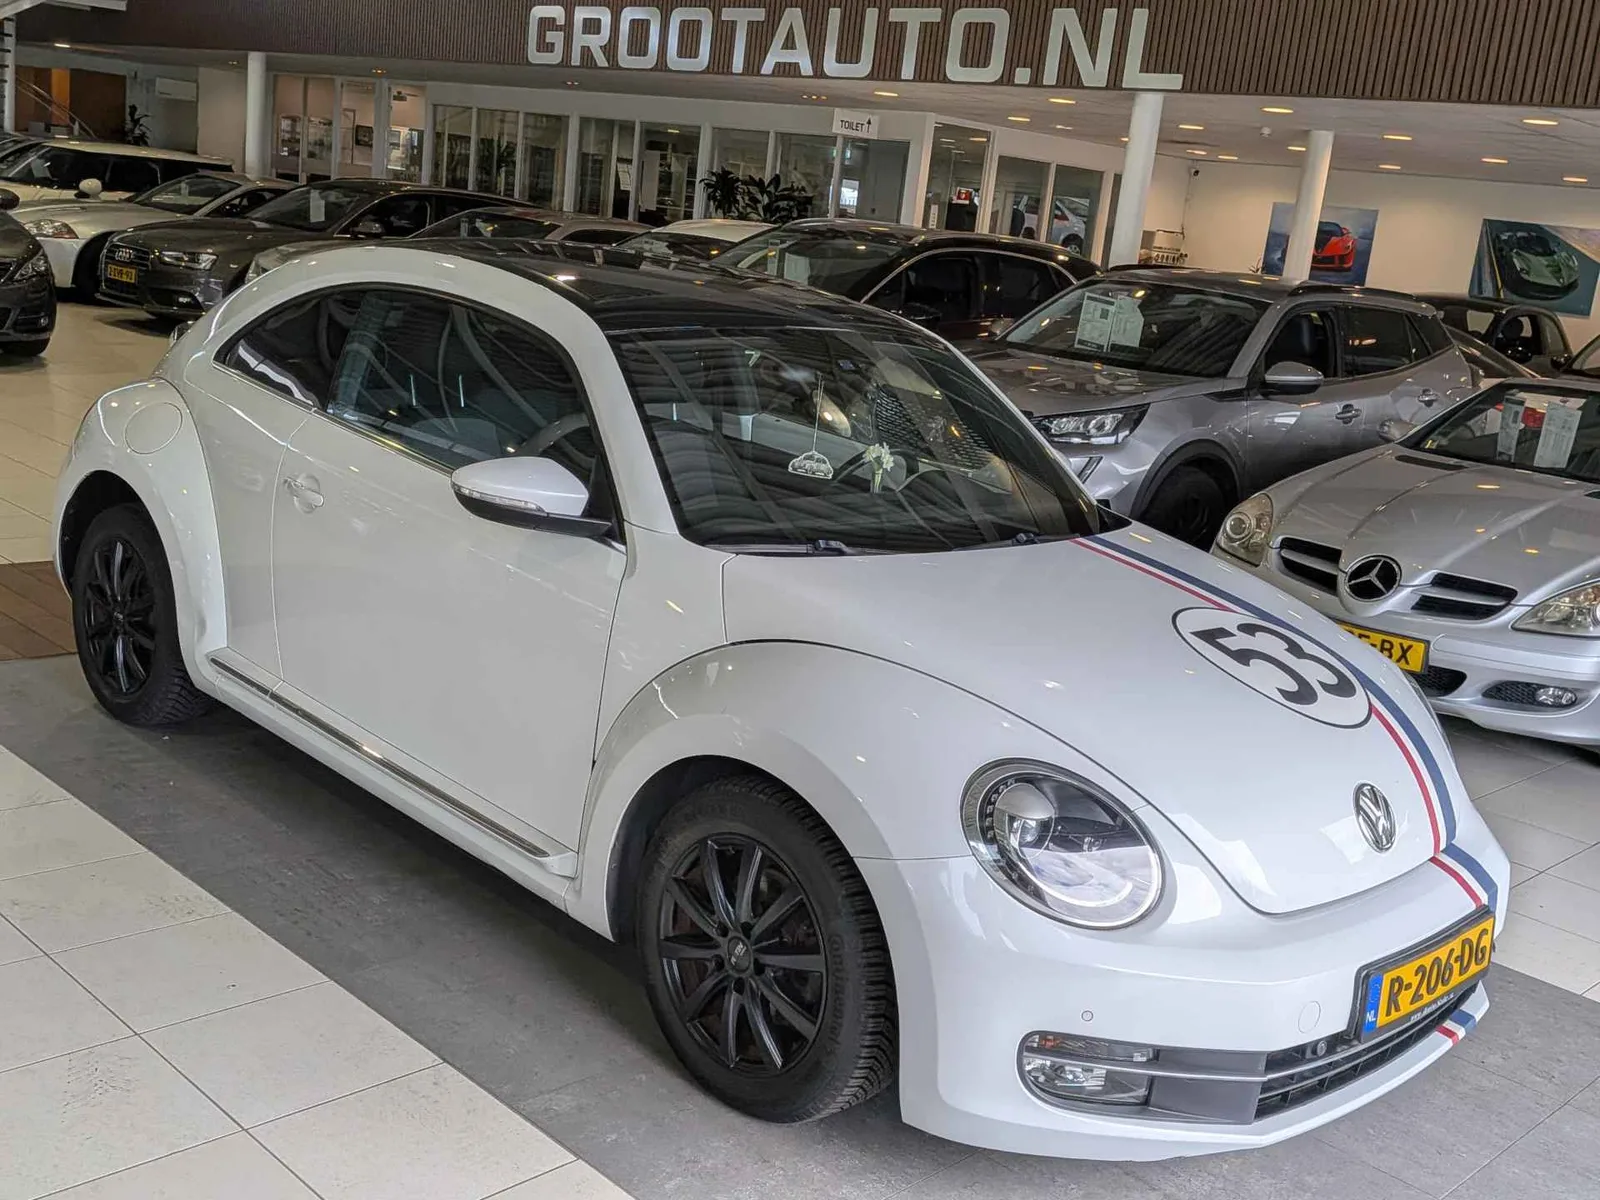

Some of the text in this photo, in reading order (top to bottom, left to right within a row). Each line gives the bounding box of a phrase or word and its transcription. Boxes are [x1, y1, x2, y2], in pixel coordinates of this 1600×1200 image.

[527, 6, 1183, 90] GROOTAUTO.NL
[840, 120, 865, 132] TOILET
[1190, 623, 1356, 705] 53
[1385, 928, 1489, 1017] R-206-DG
[1365, 1009, 1376, 1023] NL
